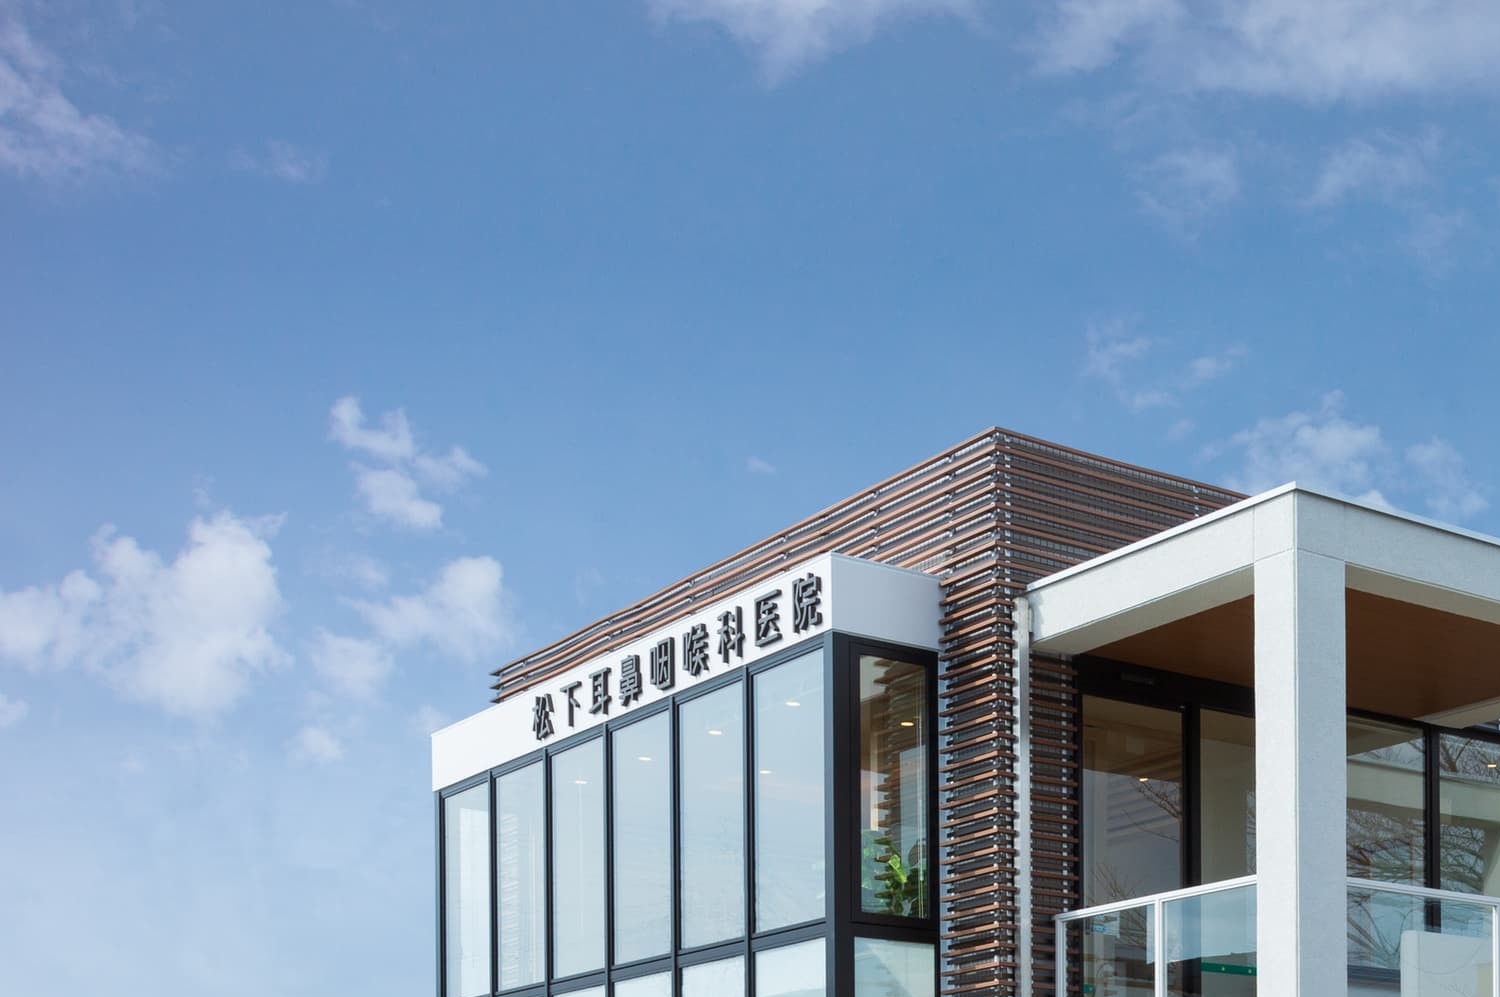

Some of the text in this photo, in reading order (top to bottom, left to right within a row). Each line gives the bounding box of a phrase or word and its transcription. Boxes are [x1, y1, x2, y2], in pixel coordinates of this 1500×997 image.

[532, 573, 823, 741] 松下耳鼻咽喉科医院
